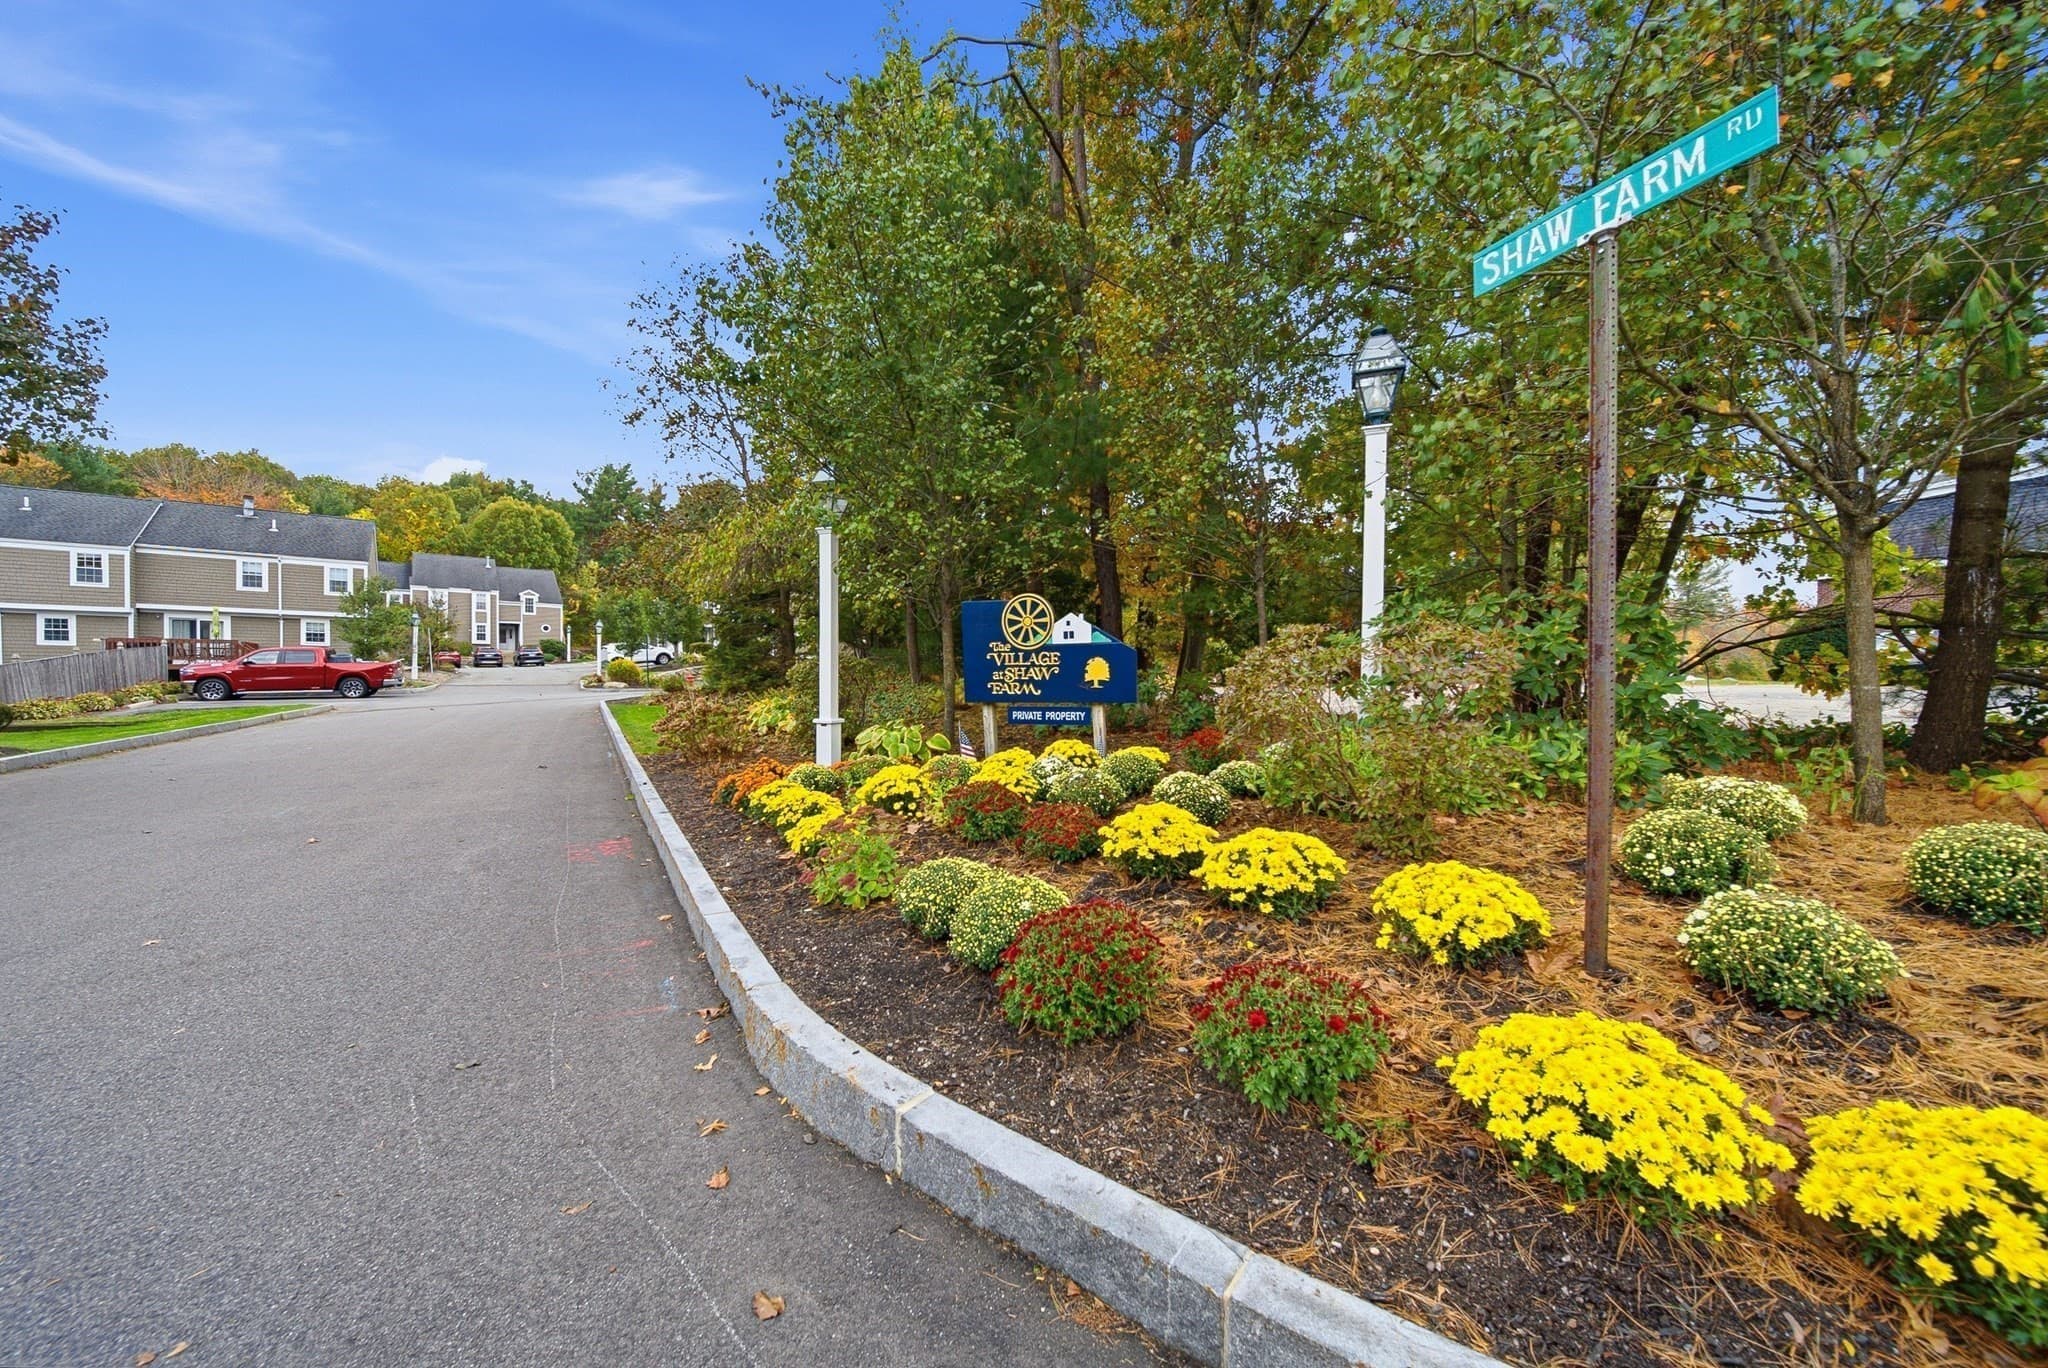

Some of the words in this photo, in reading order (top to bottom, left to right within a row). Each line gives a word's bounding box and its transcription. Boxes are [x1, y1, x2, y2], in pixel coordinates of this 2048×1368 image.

[1482, 206, 1577, 286] SHAW
[1592, 135, 1707, 231] FARM
[1727, 106, 1763, 141] RD
[989, 641, 1011, 652] The
[986, 651, 1061, 666] VILLAGE
[992, 671, 1004, 680] at
[1004, 667, 1060, 682] SHAW
[987, 681, 1041, 695] FARM
[1012, 711, 1042, 720] PRIVATE
[1045, 711, 1086, 720] PROPERTY
